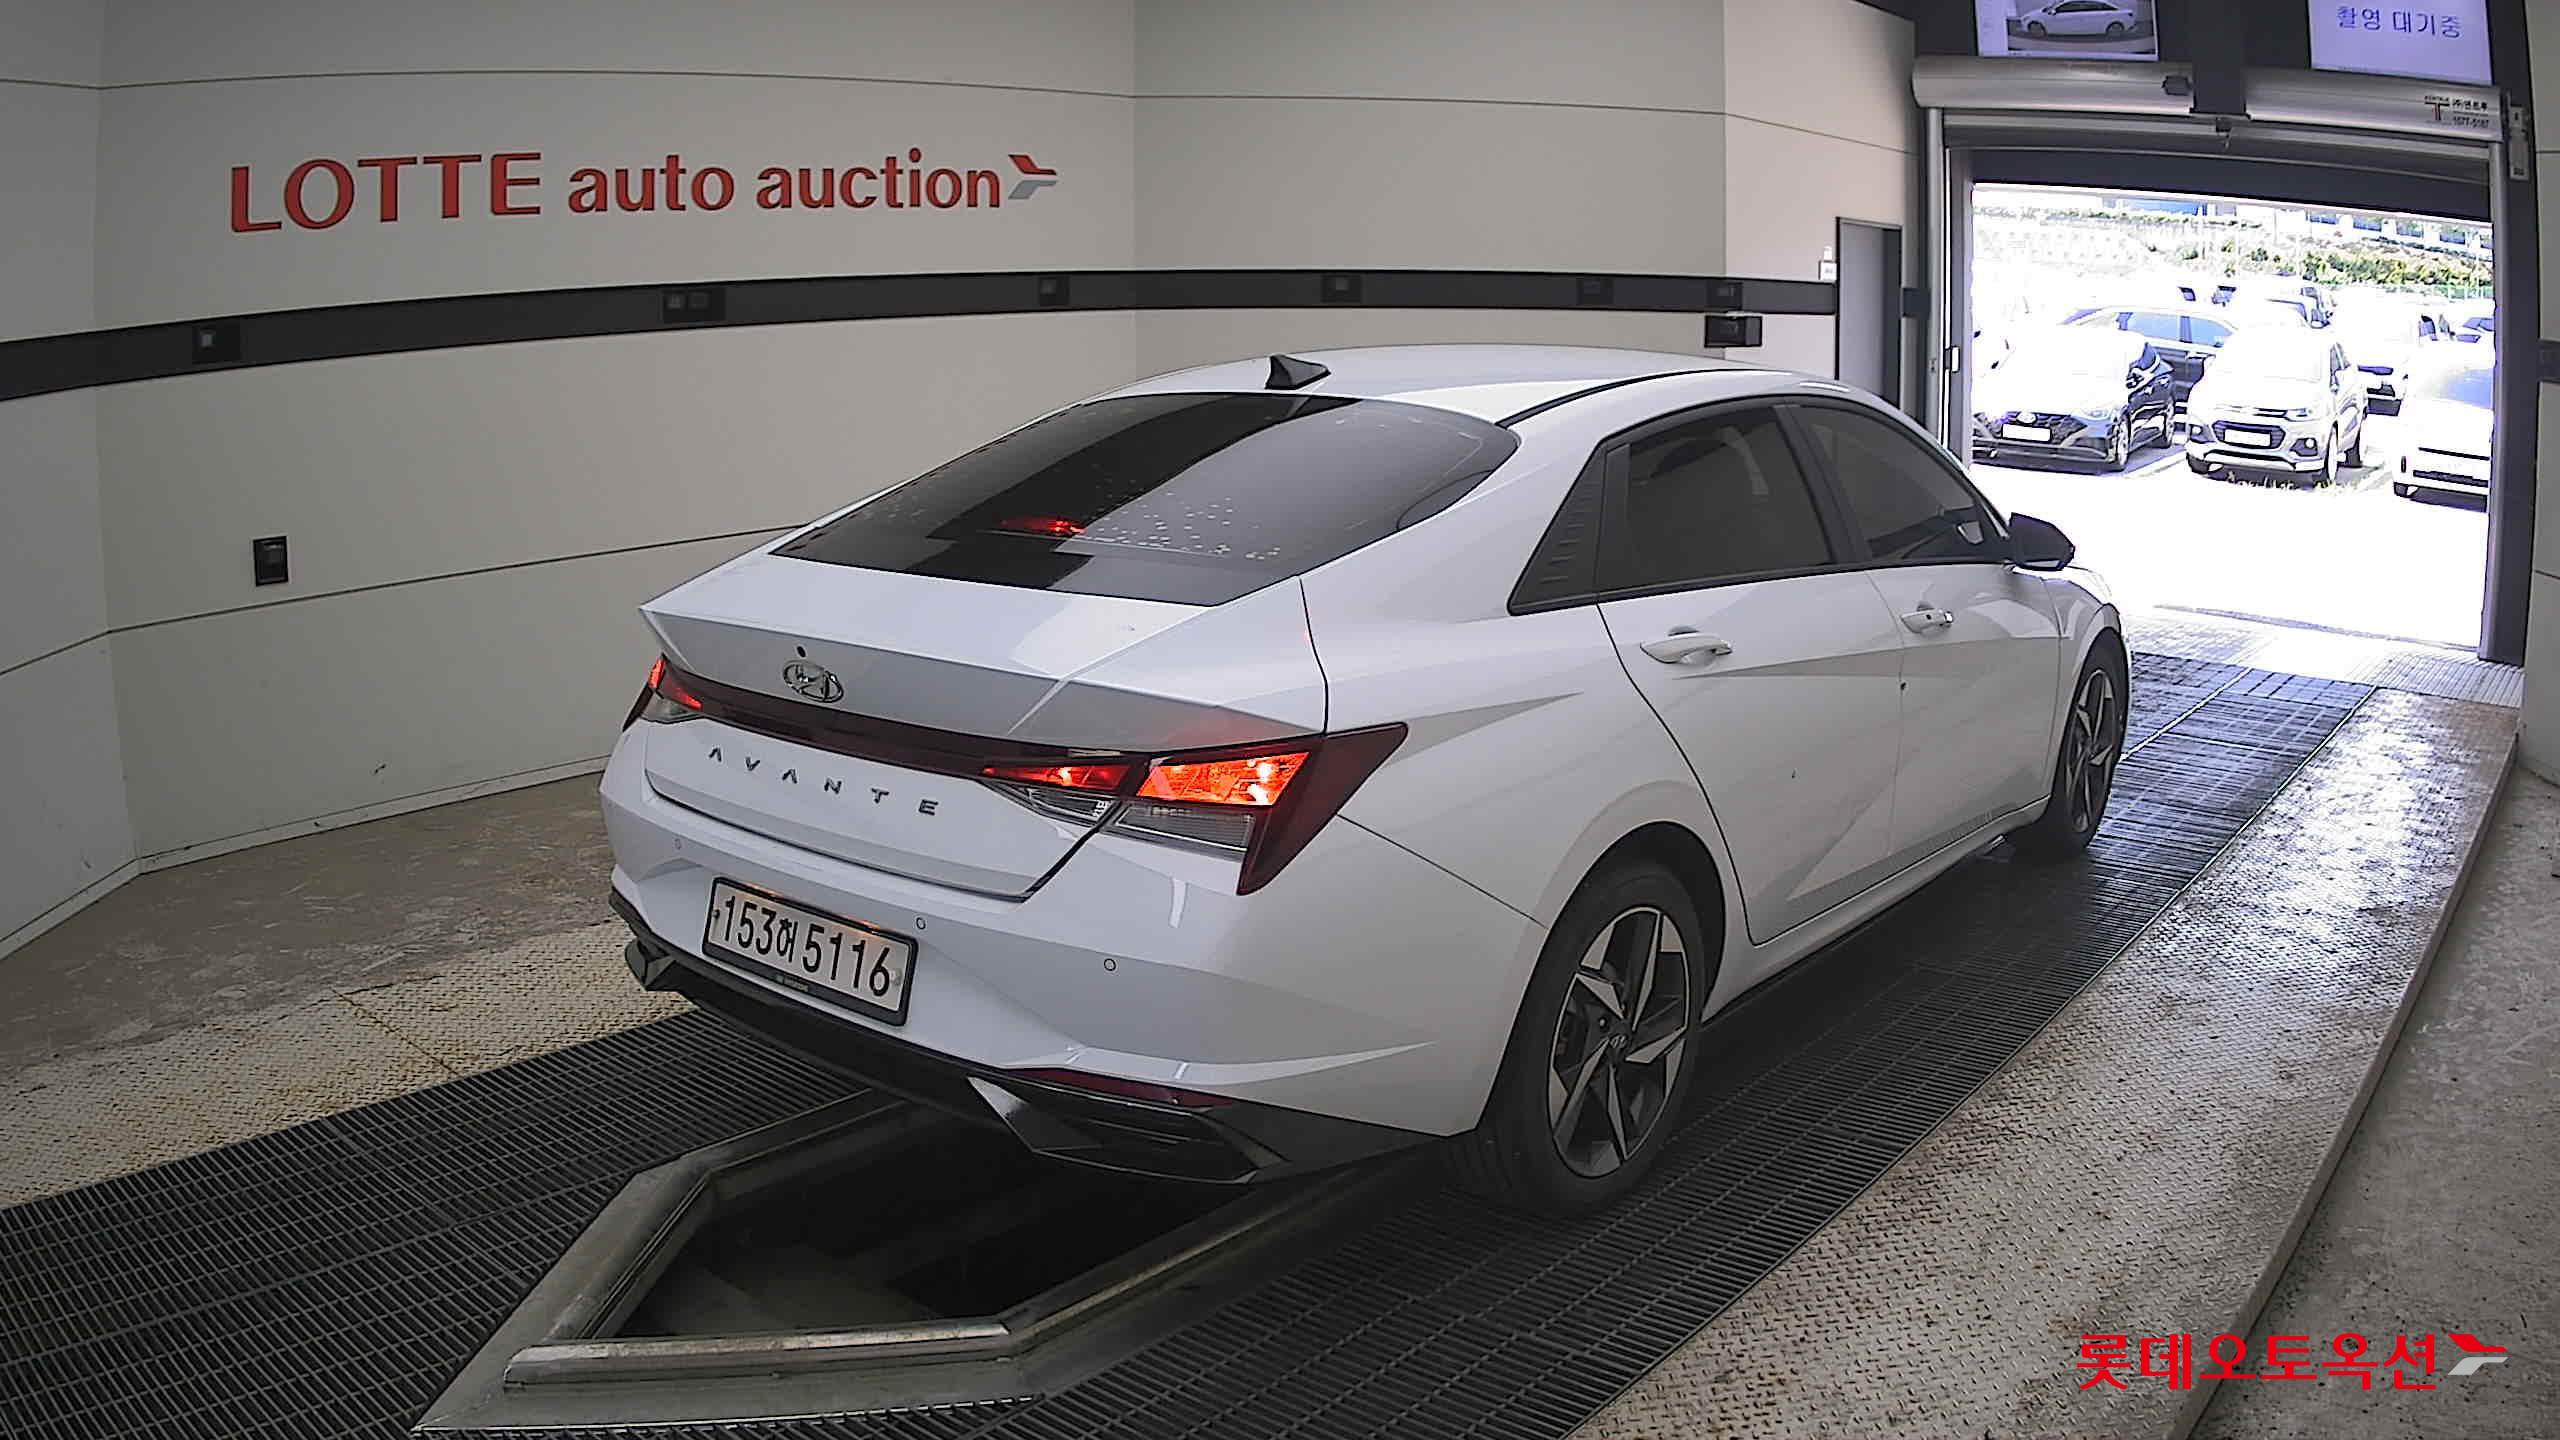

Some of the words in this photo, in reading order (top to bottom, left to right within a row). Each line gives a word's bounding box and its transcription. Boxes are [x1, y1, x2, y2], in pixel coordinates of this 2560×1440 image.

[2337, 6, 2381, 31] 촬영
[2392, 11, 2461, 38] 대기중
[231, 152, 541, 232] LOTTE
[568, 154, 735, 213] auto
[755, 147, 1001, 210] auction
[708, 747, 939, 816] AVANTE
